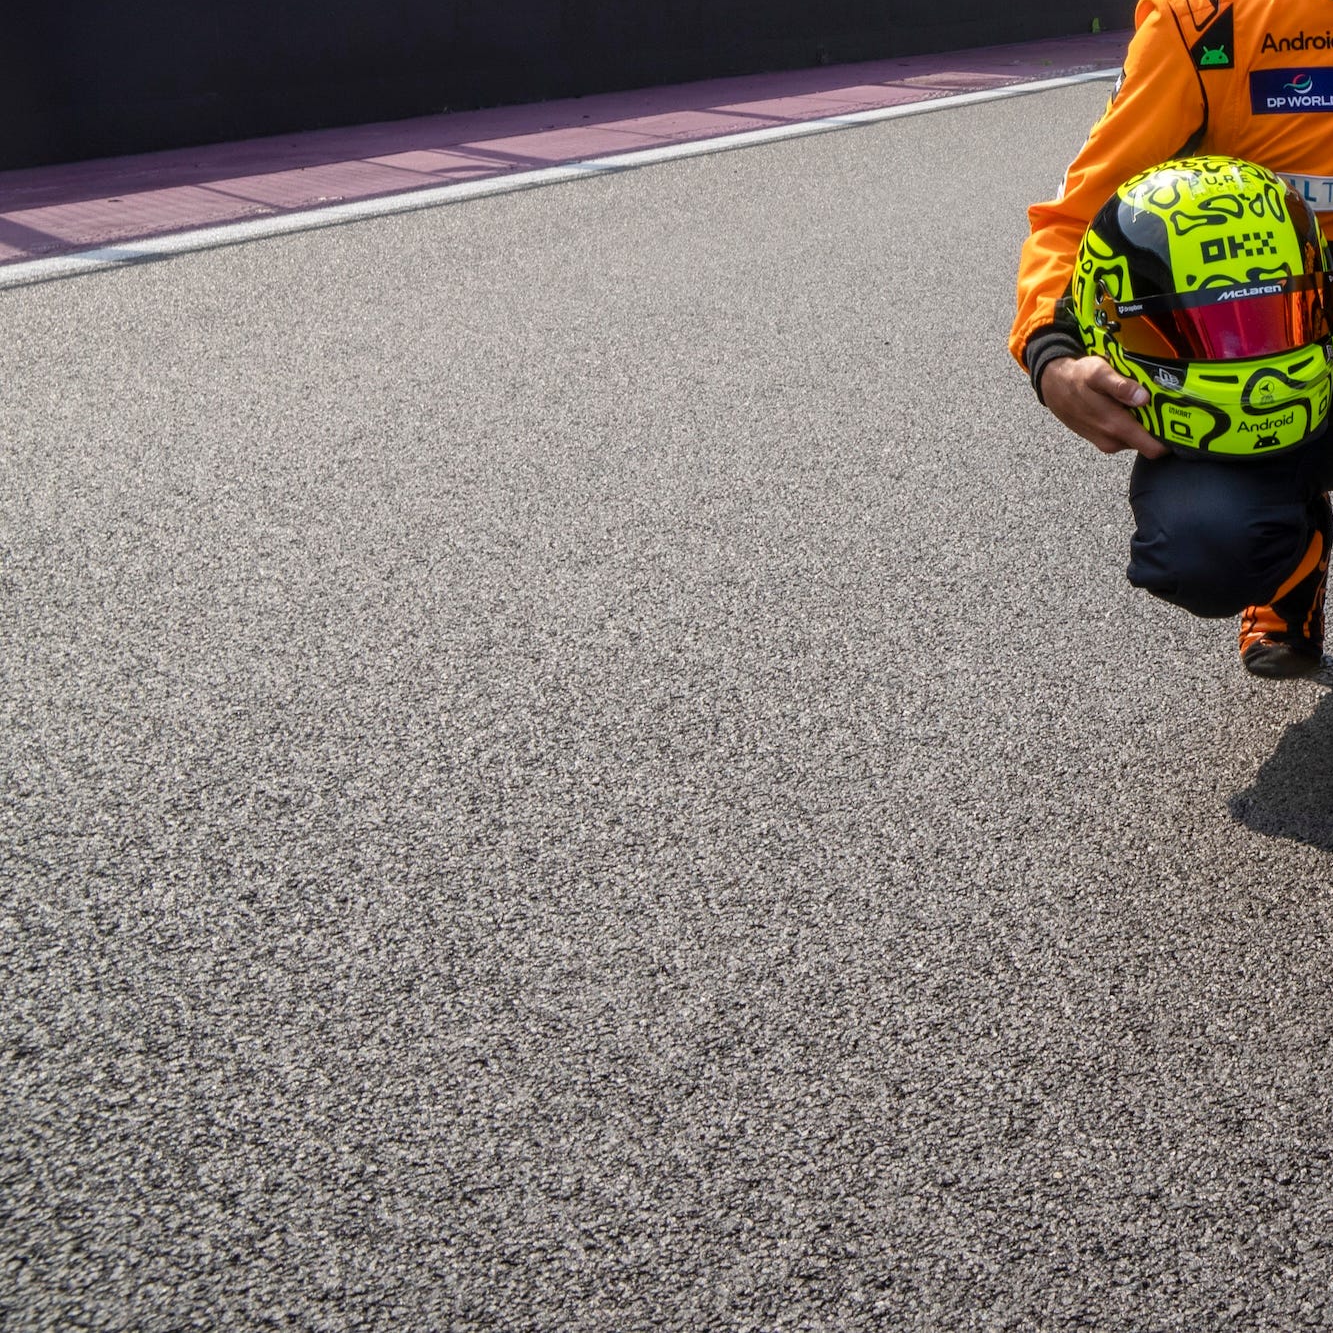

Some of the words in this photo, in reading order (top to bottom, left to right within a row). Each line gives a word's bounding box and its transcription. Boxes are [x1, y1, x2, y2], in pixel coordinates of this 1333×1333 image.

[1267, 97, 1286, 108] DP
[1200, 231, 1277, 264] OKX
[1217, 284, 1282, 302] McLaren
[1236, 410, 1294, 433] Android
